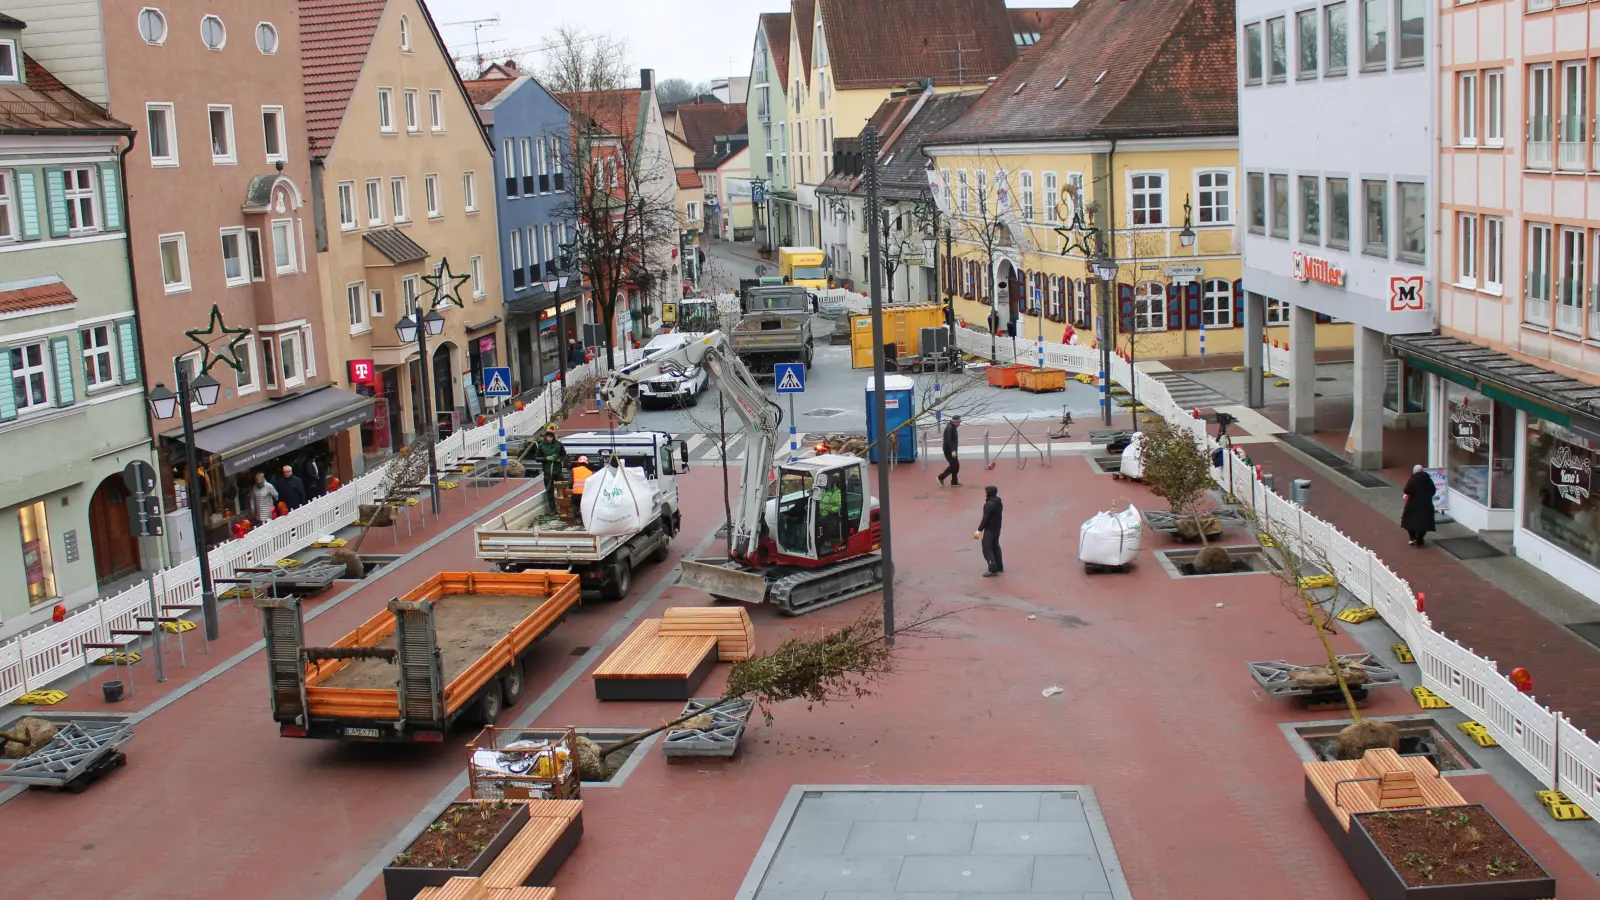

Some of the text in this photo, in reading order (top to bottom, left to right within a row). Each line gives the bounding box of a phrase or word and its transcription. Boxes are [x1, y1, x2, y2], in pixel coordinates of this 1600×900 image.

[1304, 256, 1341, 287] Müller
[1398, 286, 1416, 301] M
[355, 364, 368, 379] T
[1560, 469, 1580, 484] Keno's
